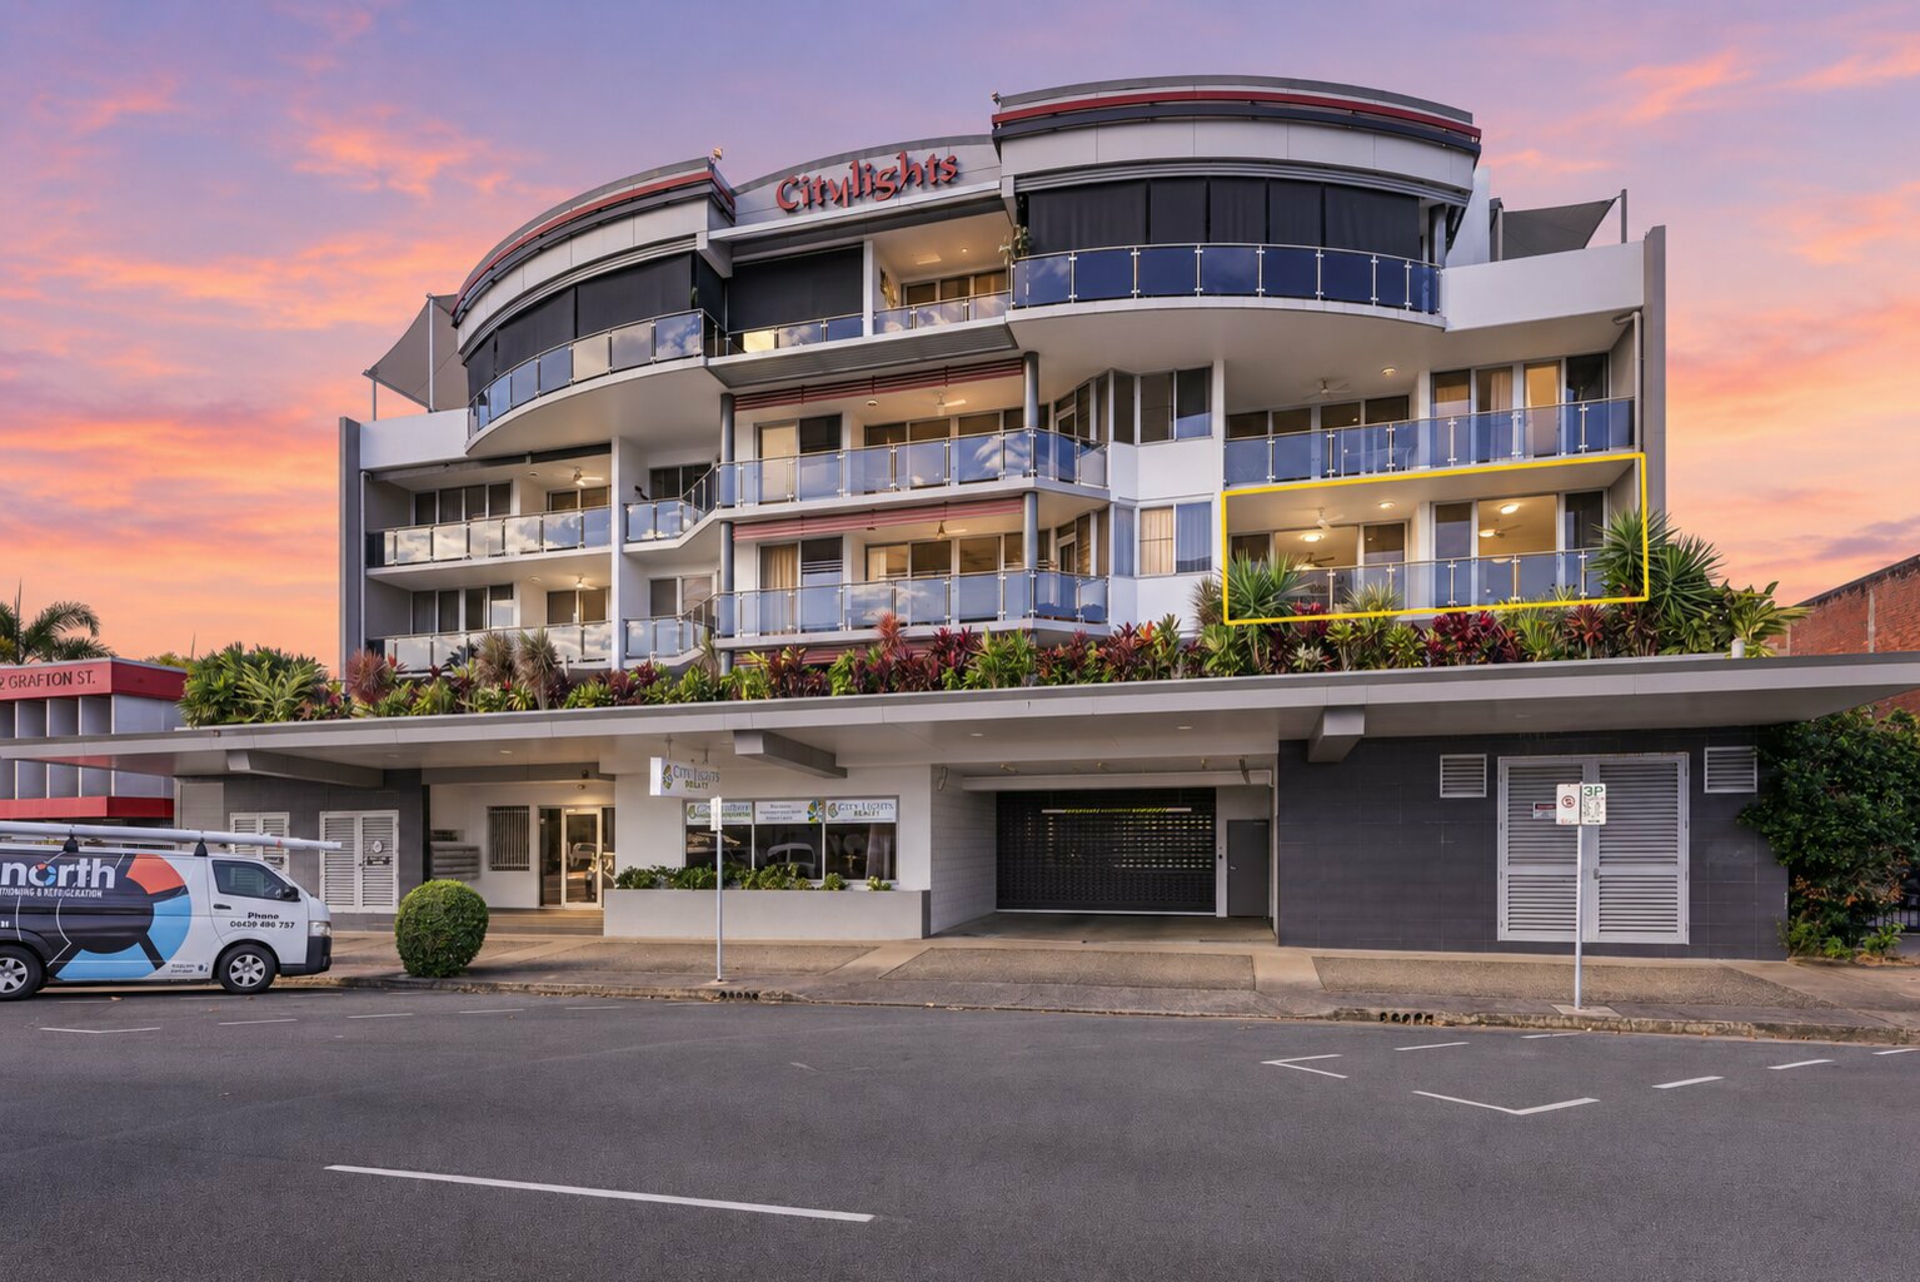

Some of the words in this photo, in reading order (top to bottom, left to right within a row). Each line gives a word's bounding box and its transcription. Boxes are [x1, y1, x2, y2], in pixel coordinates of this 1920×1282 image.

[776, 151, 958, 209] Citylights
[8, 671, 73, 689] GRAFTON
[77, 670, 96, 685] ST.
[1584, 785, 1604, 797] 3P
[0, 858, 116, 889] north
